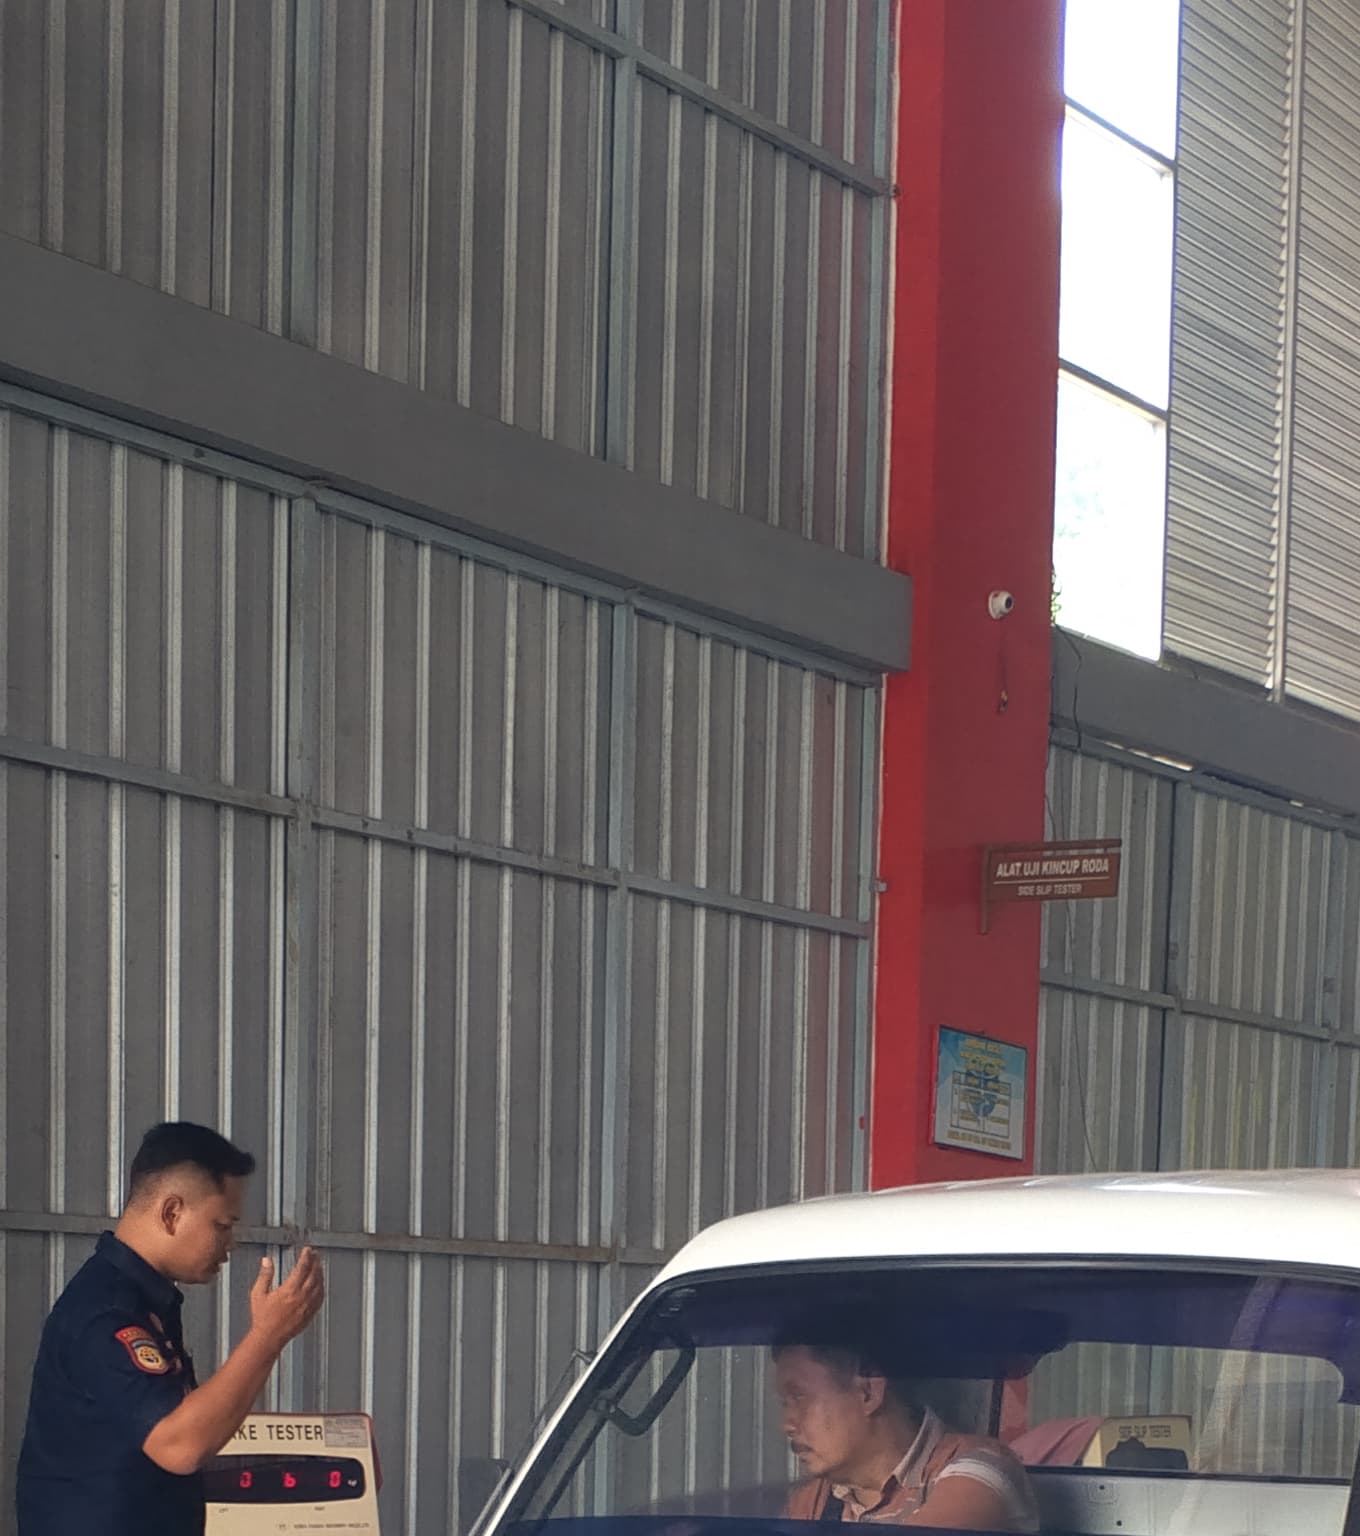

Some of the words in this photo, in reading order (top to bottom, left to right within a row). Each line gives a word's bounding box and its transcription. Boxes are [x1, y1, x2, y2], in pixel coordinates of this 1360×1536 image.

[1023, 861, 1040, 876] UJI
[1041, 859, 1080, 875] KINCUP
[1082, 858, 1109, 873] RODA
[1054, 883, 1082, 895] TESTER
[266, 1424, 324, 1441] TESTER
